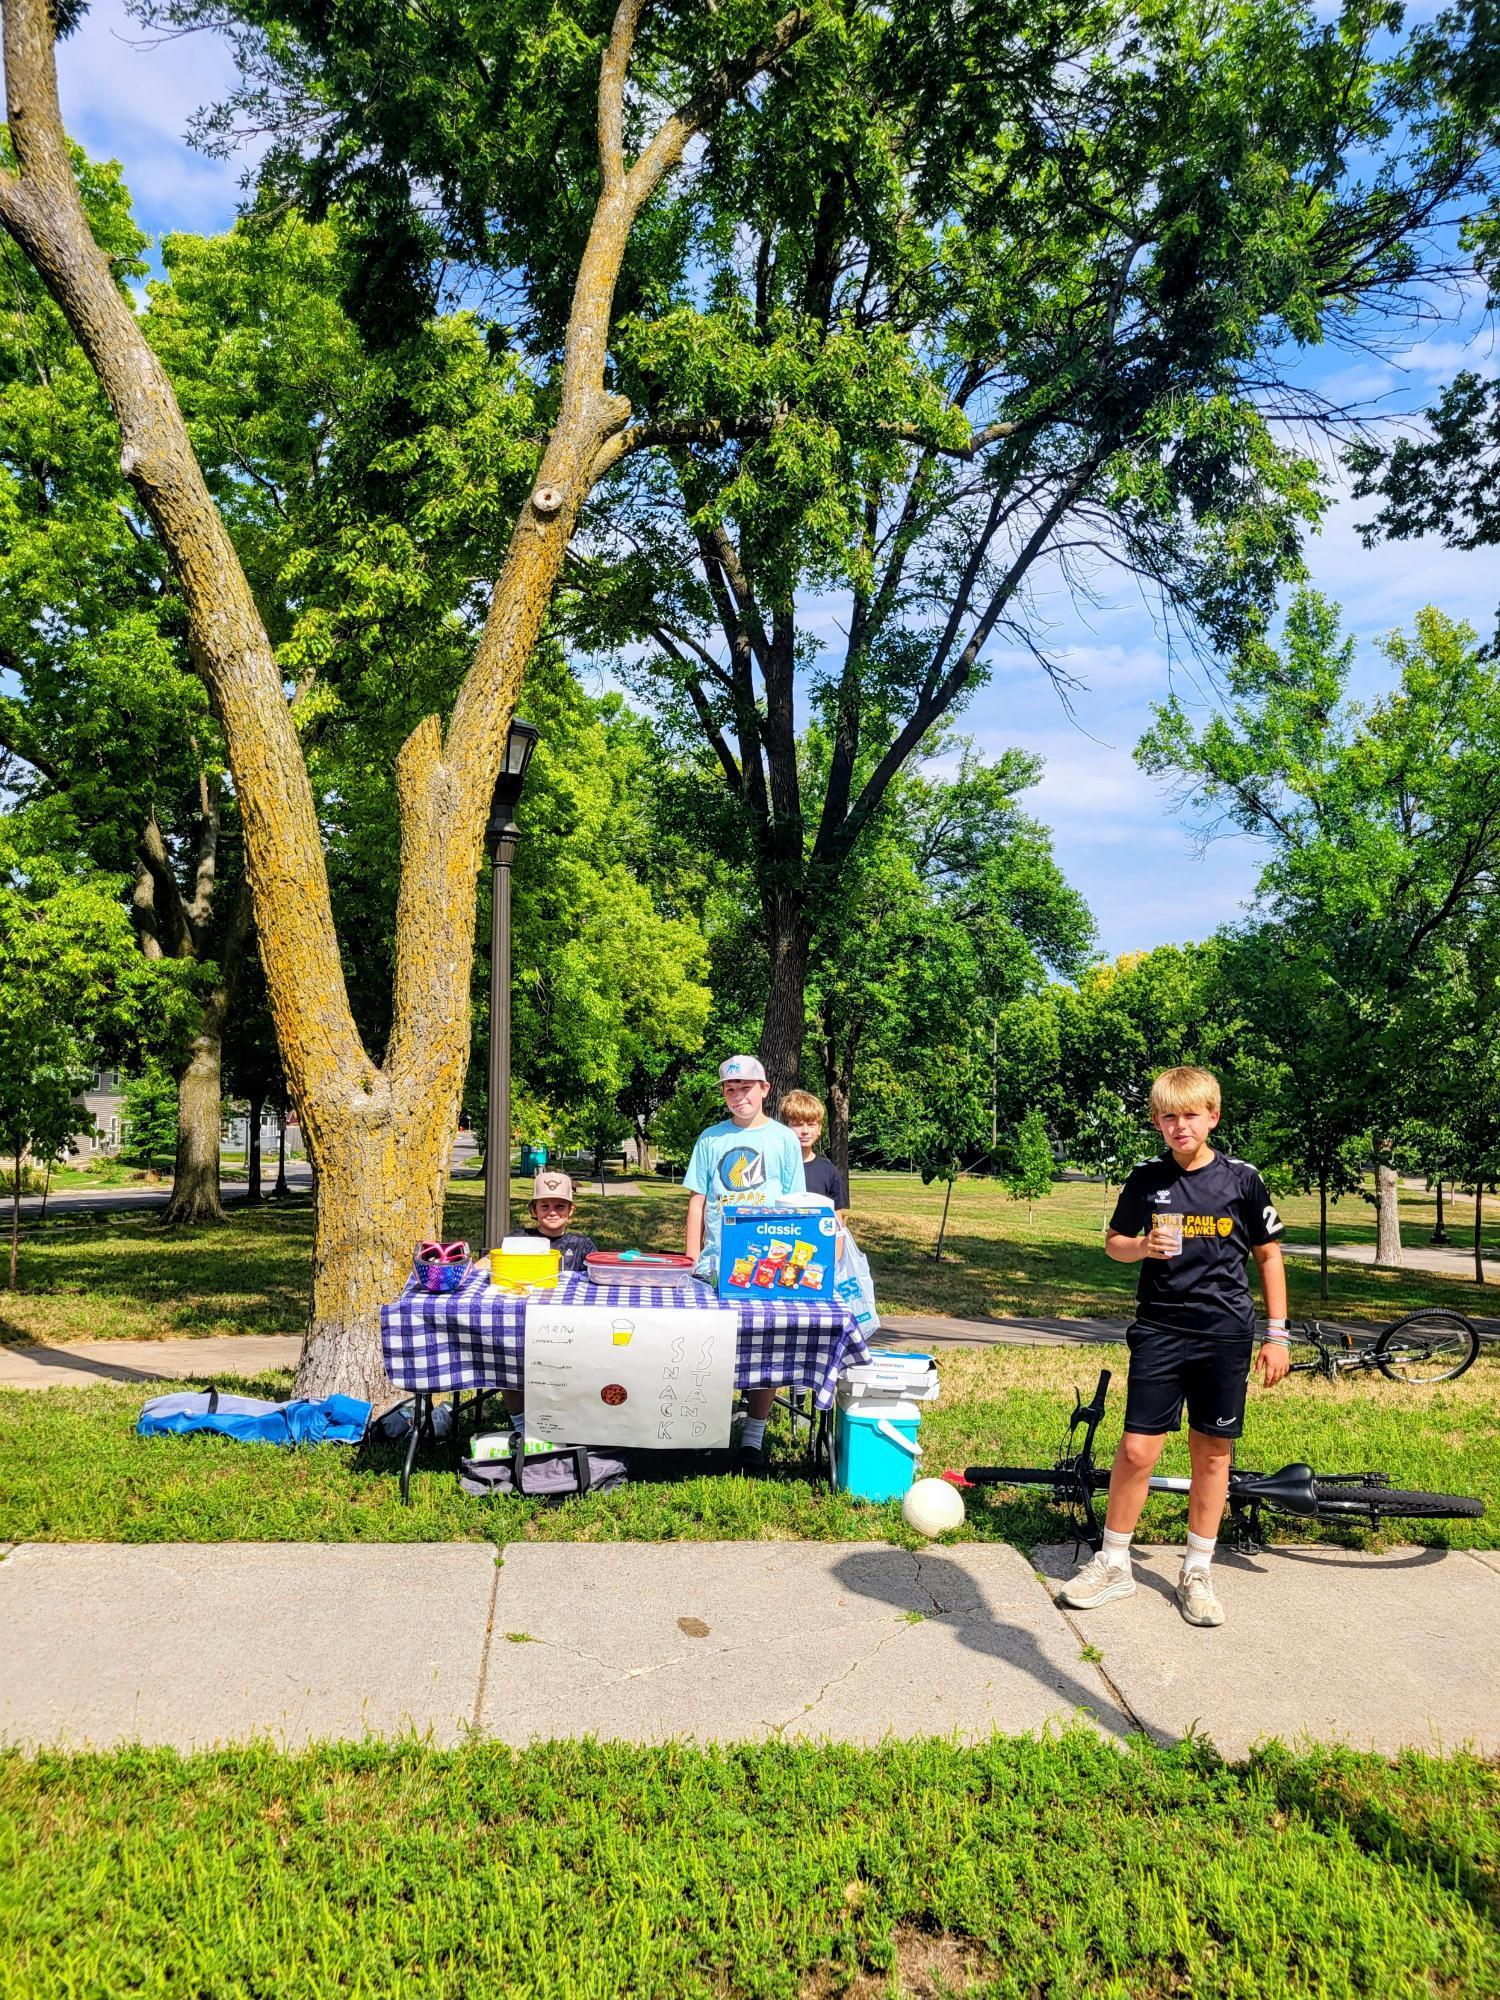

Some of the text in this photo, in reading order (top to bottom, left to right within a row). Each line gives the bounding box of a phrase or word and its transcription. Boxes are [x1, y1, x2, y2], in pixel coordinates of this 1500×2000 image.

[756, 1223, 802, 1235] classic
[1187, 1215, 1216, 1226] PAUL
[1262, 1205, 1283, 1235] 2
[657, 1336, 685, 1440] SNACK
[682, 1335, 715, 1438] STAND
